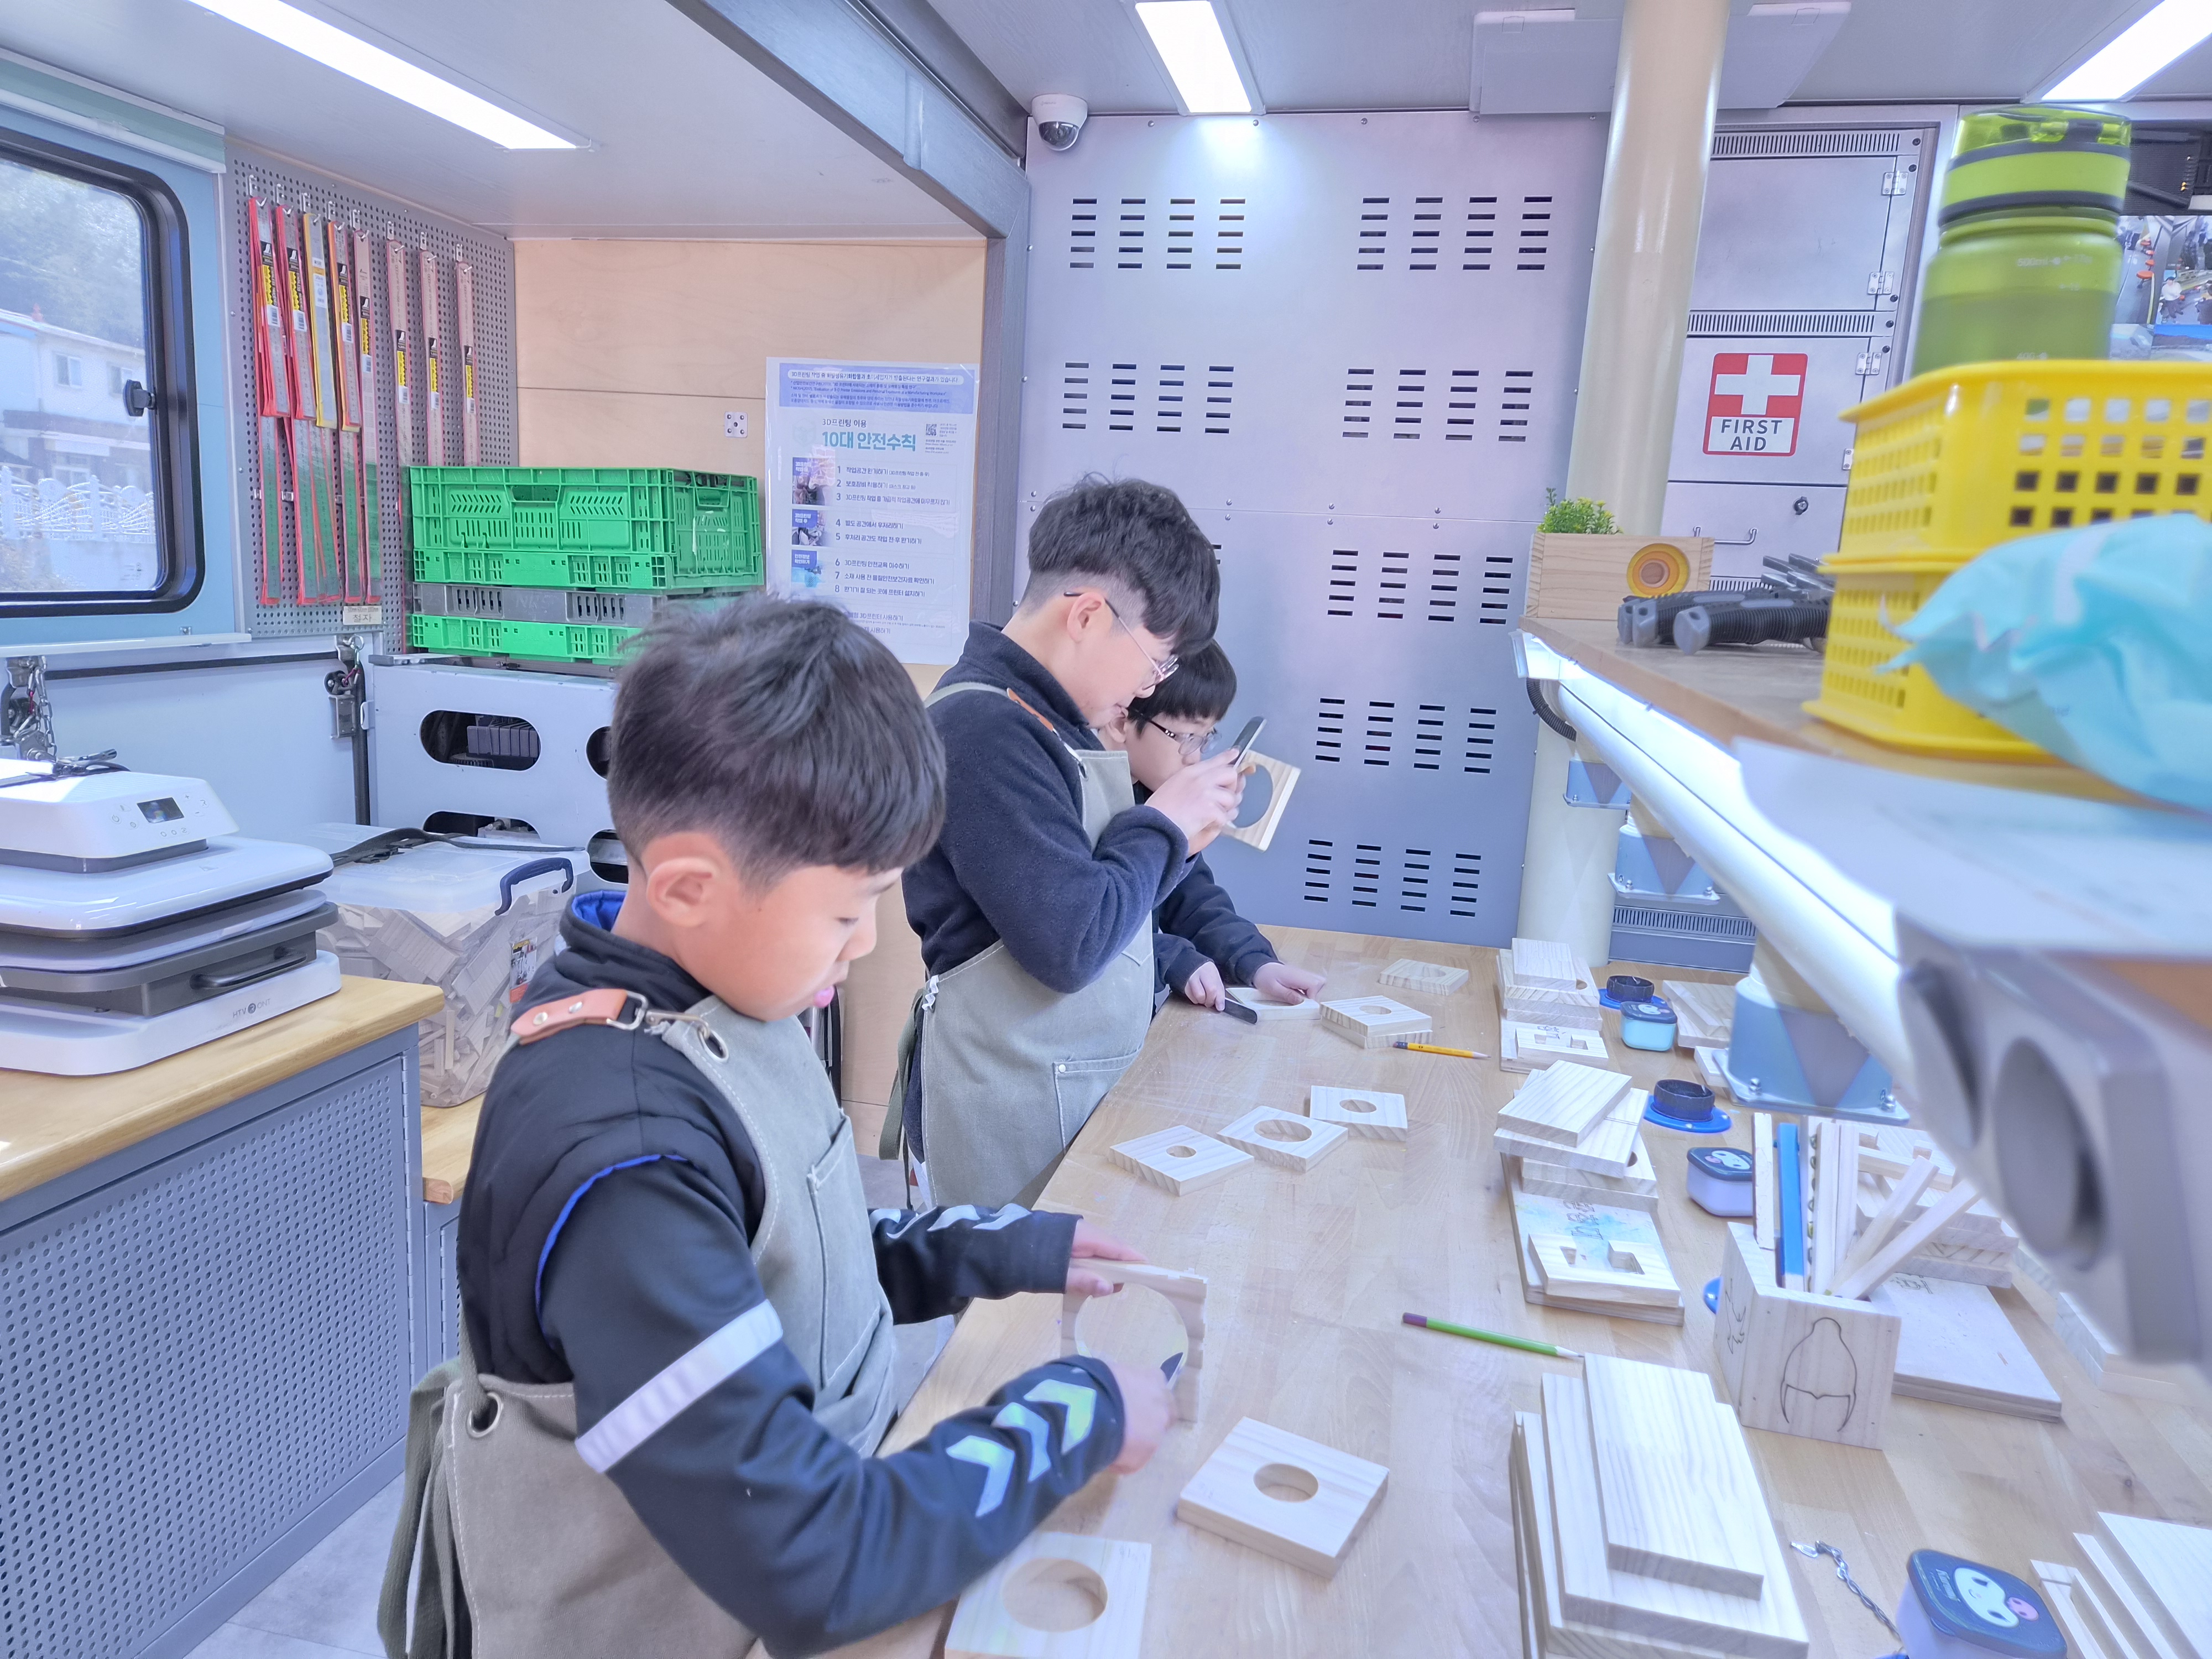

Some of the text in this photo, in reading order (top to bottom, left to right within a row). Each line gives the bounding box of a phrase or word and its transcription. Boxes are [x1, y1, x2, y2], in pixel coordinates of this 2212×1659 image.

[822, 419, 867, 428] 3D프린팅 이용
[1721, 419, 1783, 435] FIRST
[822, 431, 916, 451] 10대 안전수칙
[1730, 436, 1767, 451] AID
[837, 466, 841, 474] 1
[837, 479, 842, 487] 2
[836, 493, 841, 501] 3
[836, 533, 841, 541] 5
[835, 558, 840, 566] 6
[873, 575, 913, 583] 물질안전보건자료
